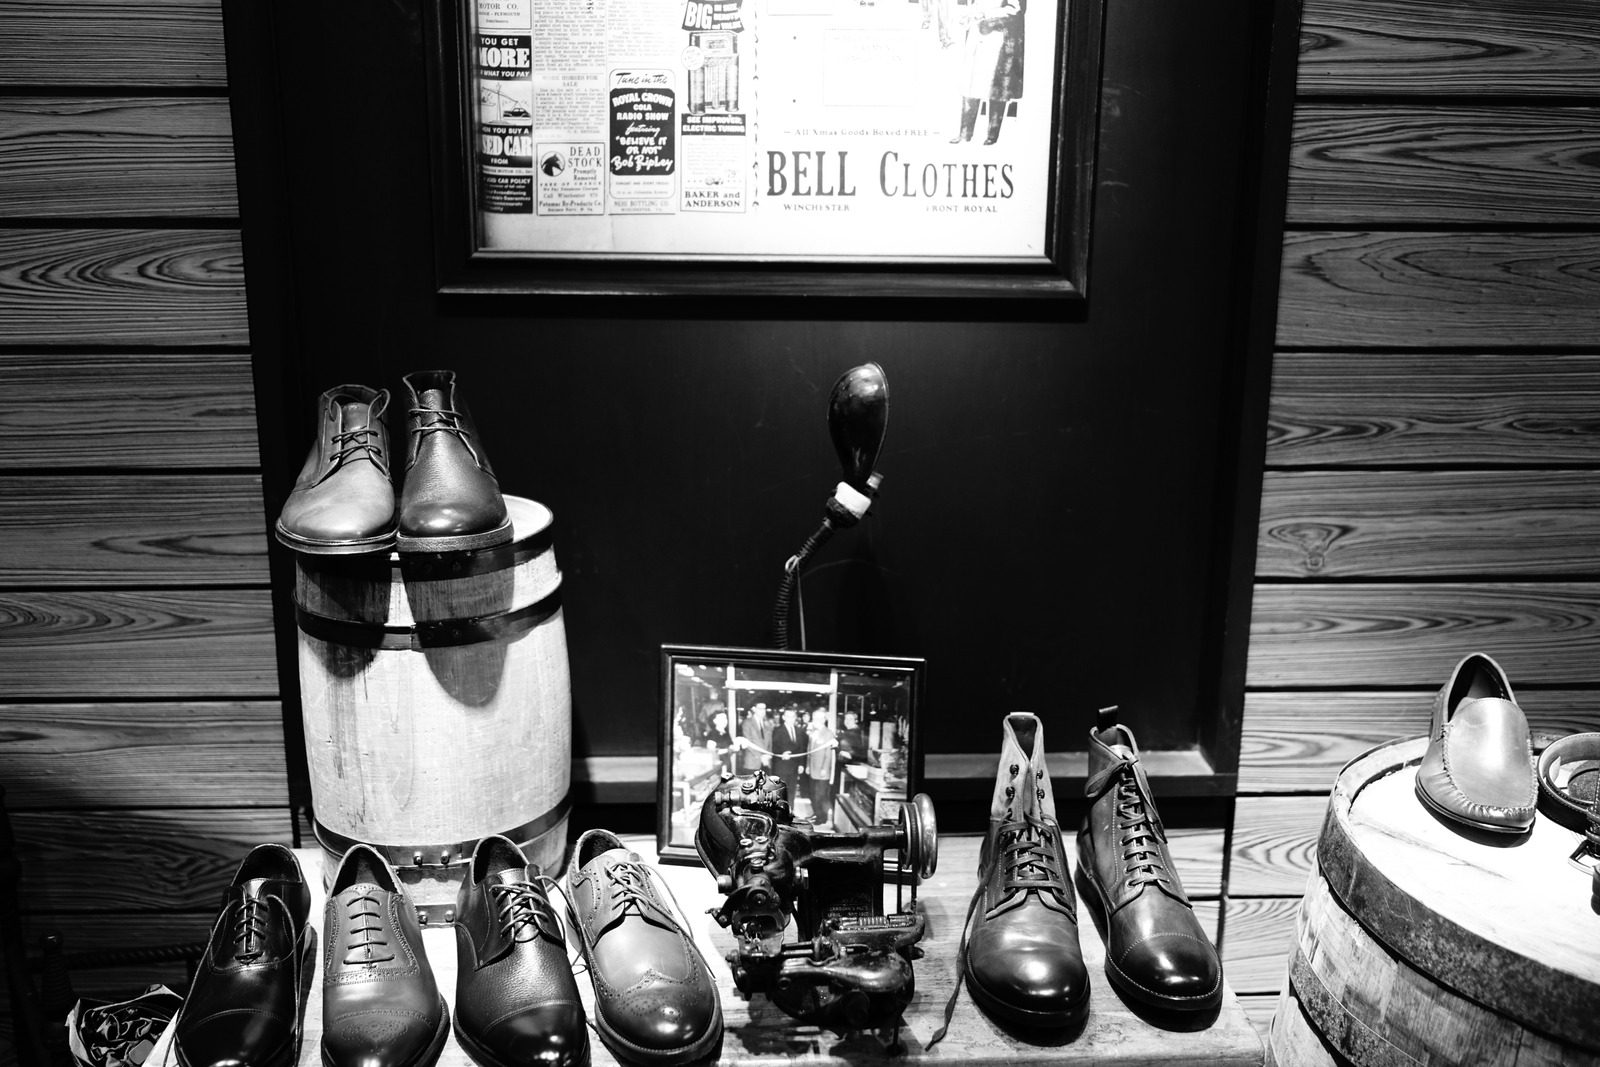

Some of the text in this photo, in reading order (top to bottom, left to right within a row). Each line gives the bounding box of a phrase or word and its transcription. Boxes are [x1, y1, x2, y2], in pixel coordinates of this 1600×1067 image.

[685, 2, 713, 29] BIG
[481, 37, 518, 46] YOU GET
[612, 92, 673, 108] ROYAL CROWN
[617, 112, 669, 121] RADIO SHOW
[504, 135, 532, 156] CAR
[658, 137, 667, 146] IT
[570, 146, 601, 157] DEAD
[568, 157, 602, 167] STOCK
[611, 155, 633, 171] Bob
[766, 150, 857, 197] BELL
[879, 150, 1014, 199] CLOTHES
[685, 191, 740, 199] BAKER and
[685, 200, 740, 208] ANDERSON
[783, 203, 850, 212] WINCHESTER
[963, 205, 998, 213] ROYAL
